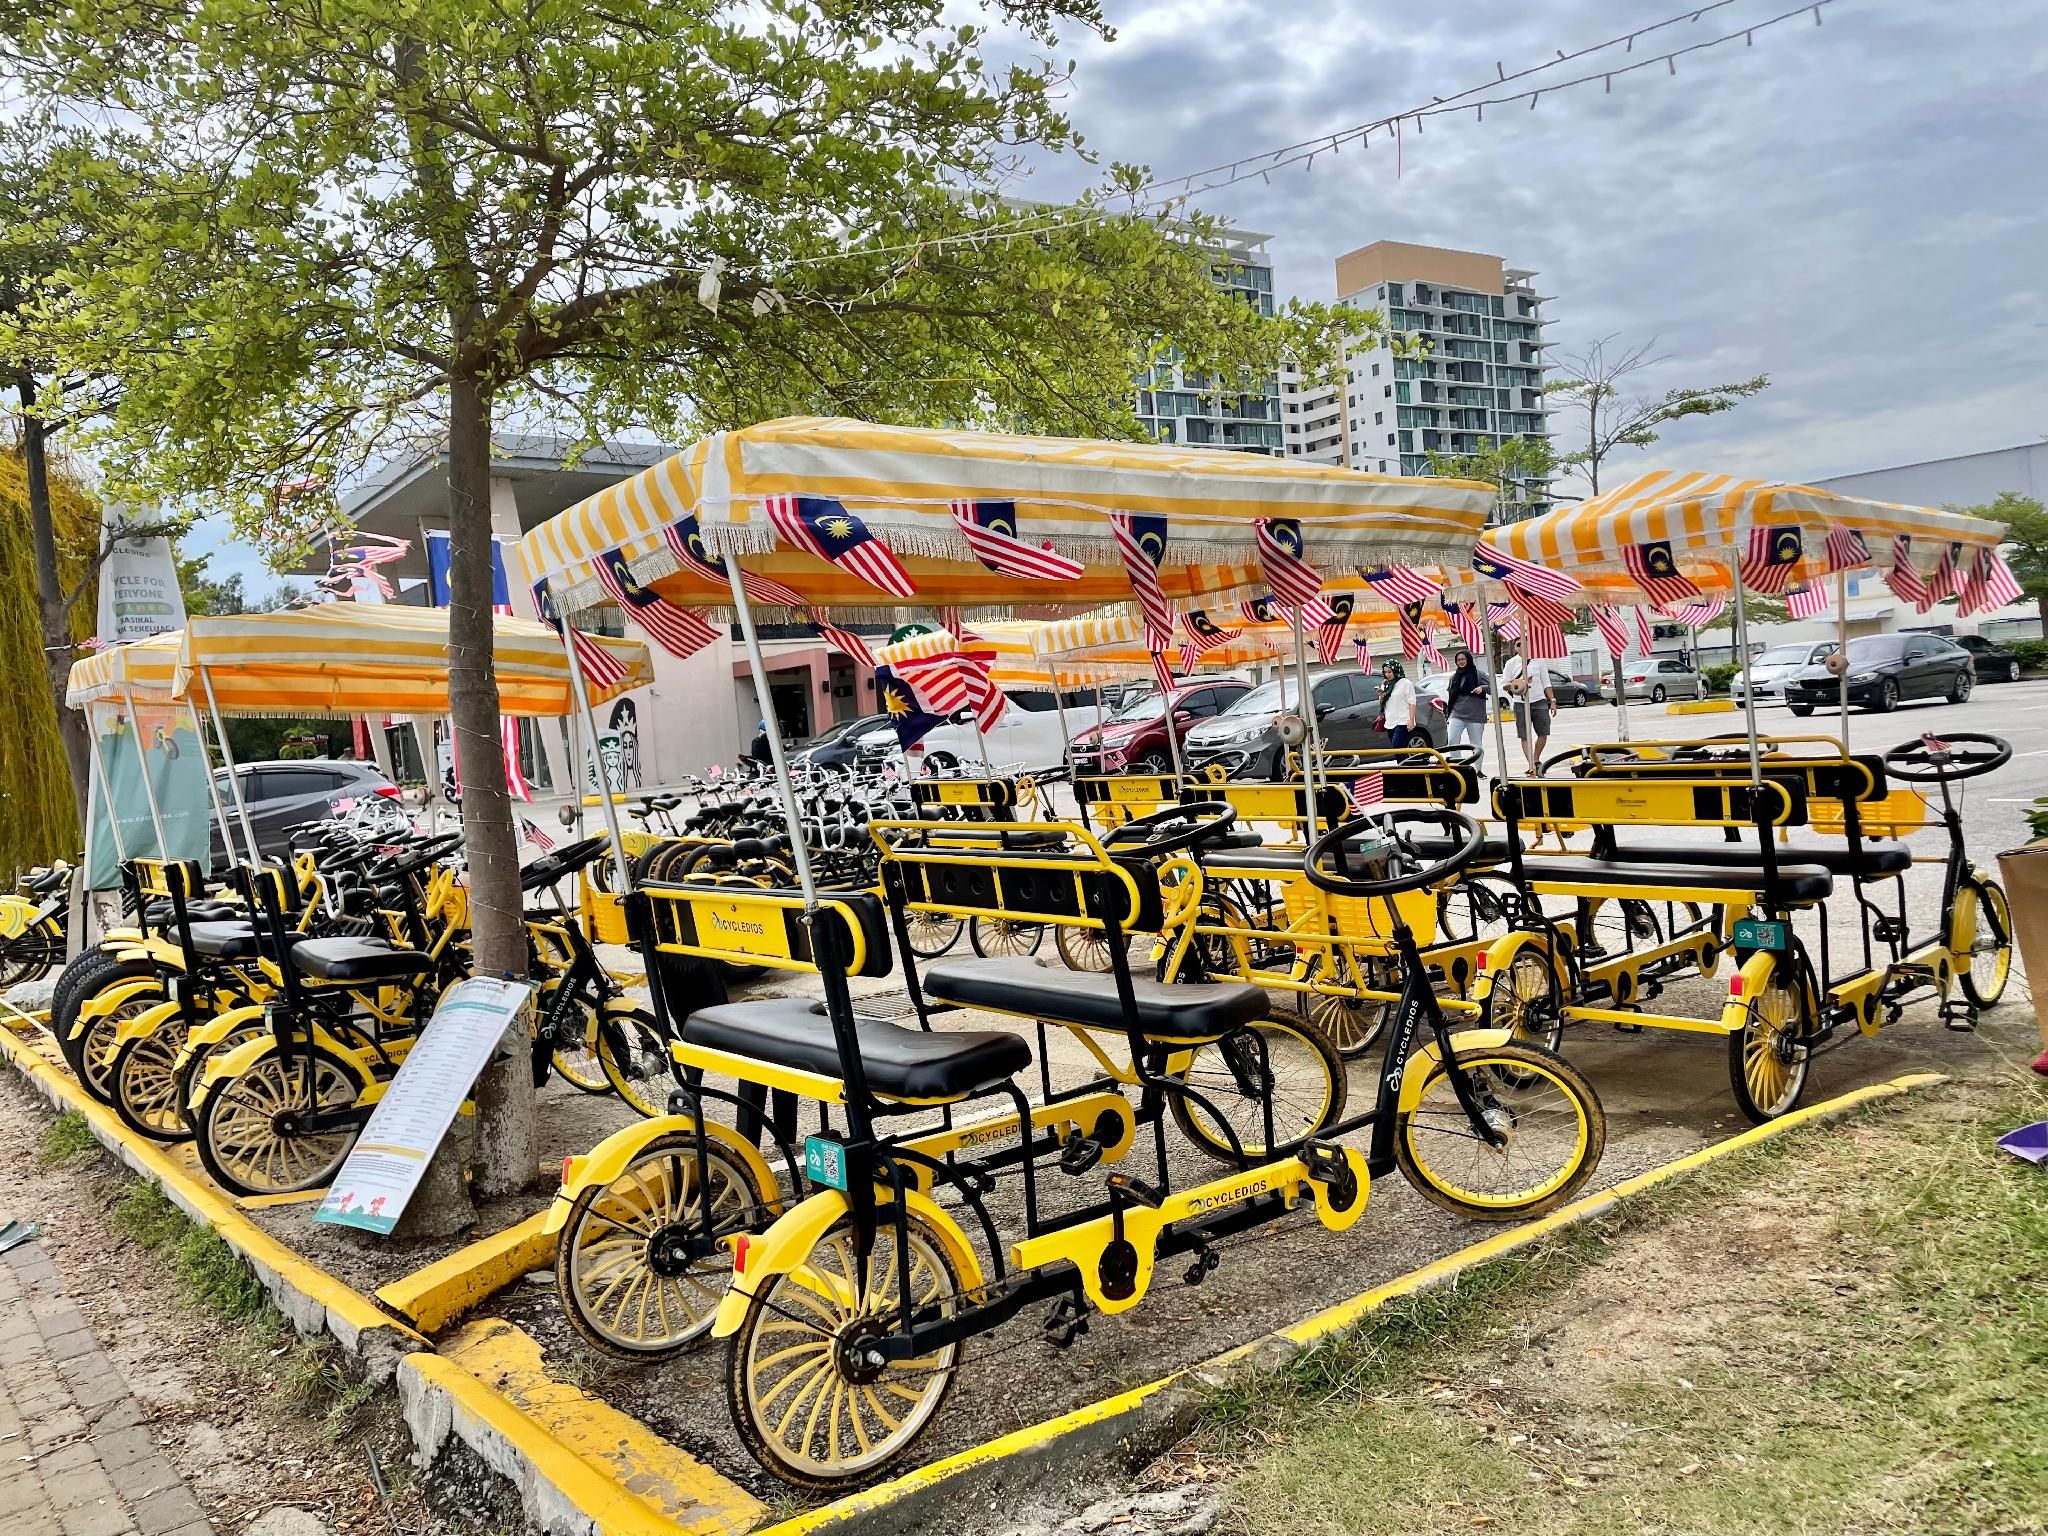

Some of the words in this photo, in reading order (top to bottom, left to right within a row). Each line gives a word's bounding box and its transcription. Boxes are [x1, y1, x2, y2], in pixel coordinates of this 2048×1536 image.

[111, 574, 141, 587] YCLE
[143, 576, 166, 587] FOR
[722, 919, 764, 934] CYCLEDIOS
[551, 977, 577, 1022] CYCLEDIOS
[1396, 999, 1419, 1065] CYCLEDIOS
[360, 1048, 409, 1063] YCLDIOS
[1206, 1180, 1267, 1207] CYCLEDIOS
